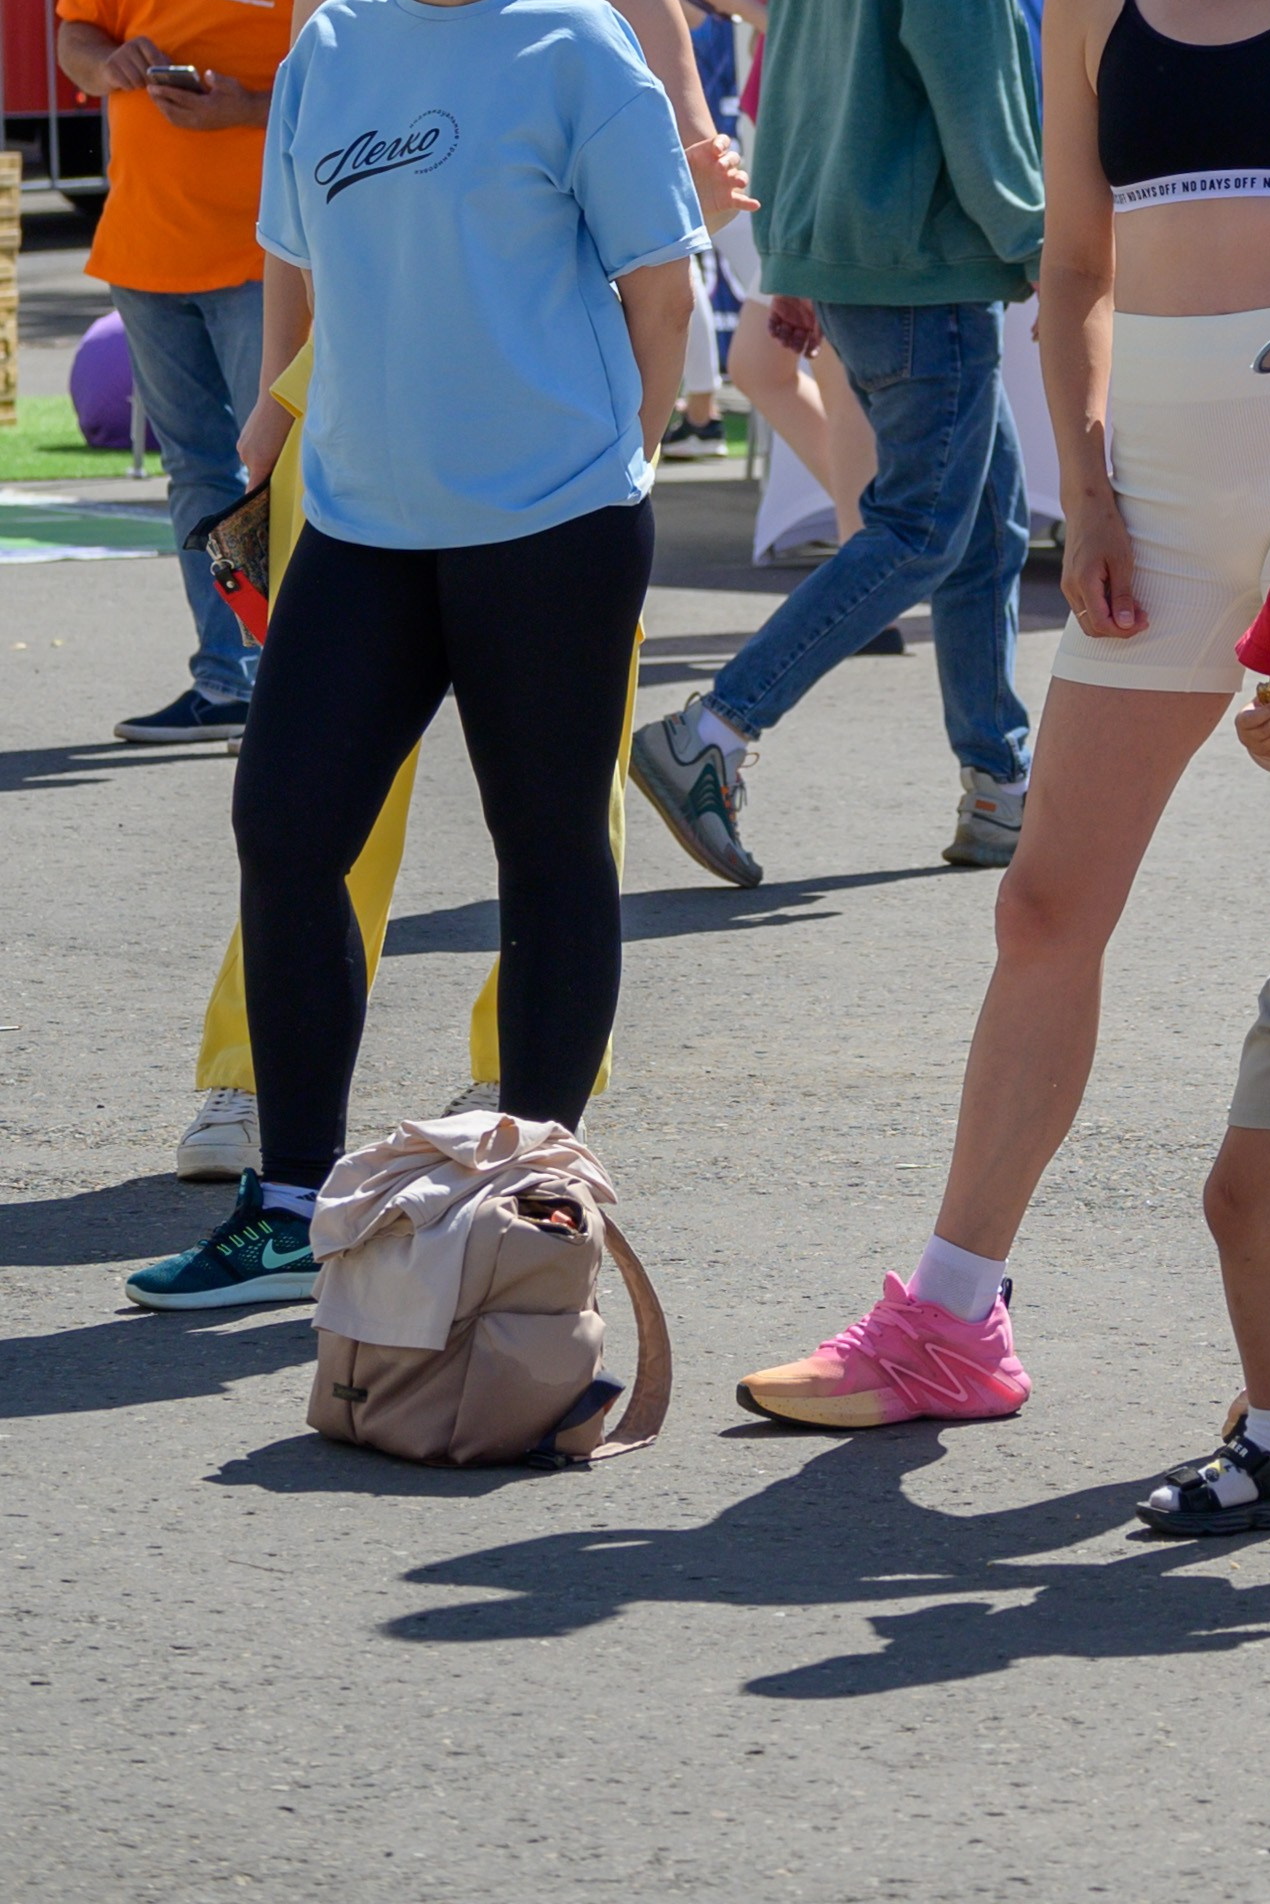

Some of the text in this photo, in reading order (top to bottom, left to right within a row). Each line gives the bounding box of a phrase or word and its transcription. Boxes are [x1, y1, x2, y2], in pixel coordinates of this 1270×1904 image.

[314, 127, 440, 186] Легко
[1137, 187, 1158, 201] DAYS
[1159, 182, 1177, 196] OFF
[1182, 180, 1197, 193] NO
[1200, 178, 1231, 192] DAYS
[1234, 177, 1257, 189] OFF
